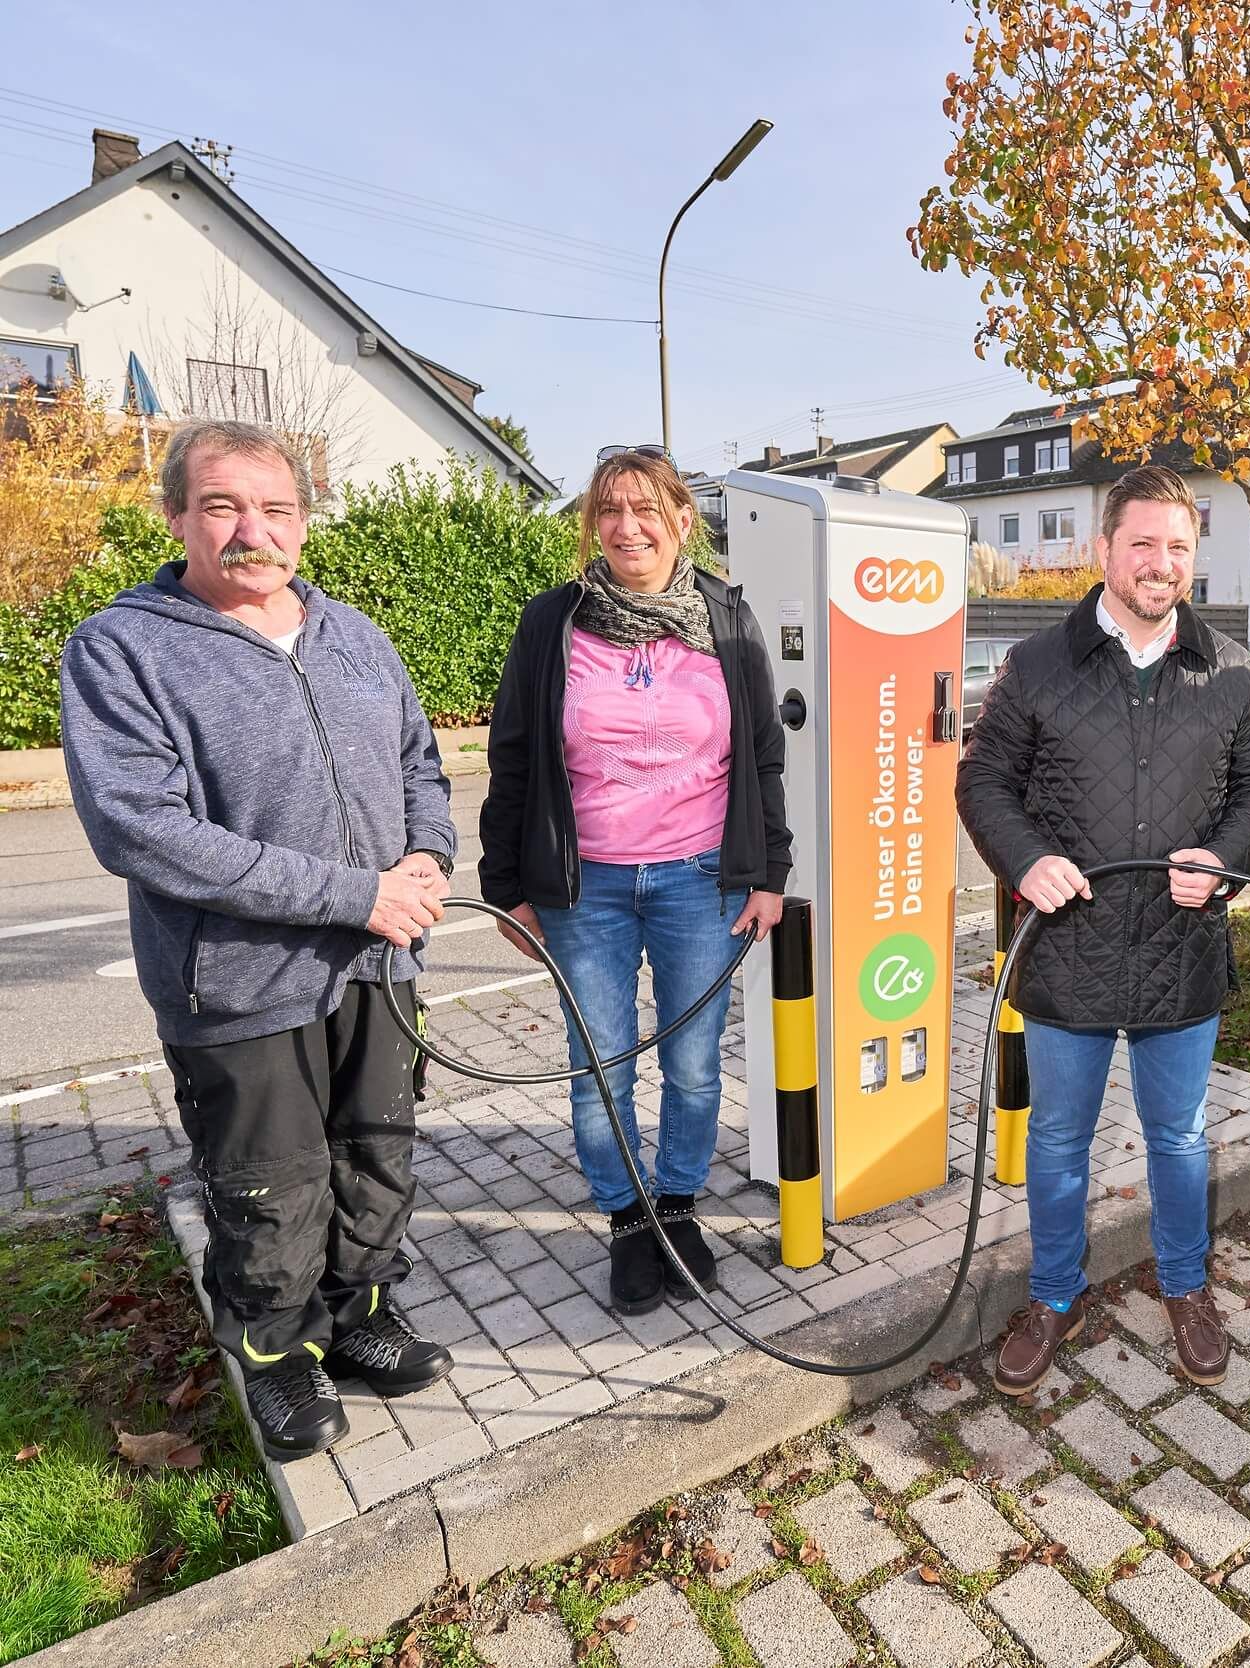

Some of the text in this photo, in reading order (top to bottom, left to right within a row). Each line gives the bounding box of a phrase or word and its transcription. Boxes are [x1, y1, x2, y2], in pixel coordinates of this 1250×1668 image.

[862, 565, 937, 595] evm
[869, 673, 896, 921] Unser Ökostrom.
[902, 727, 923, 916] Deine Power.
